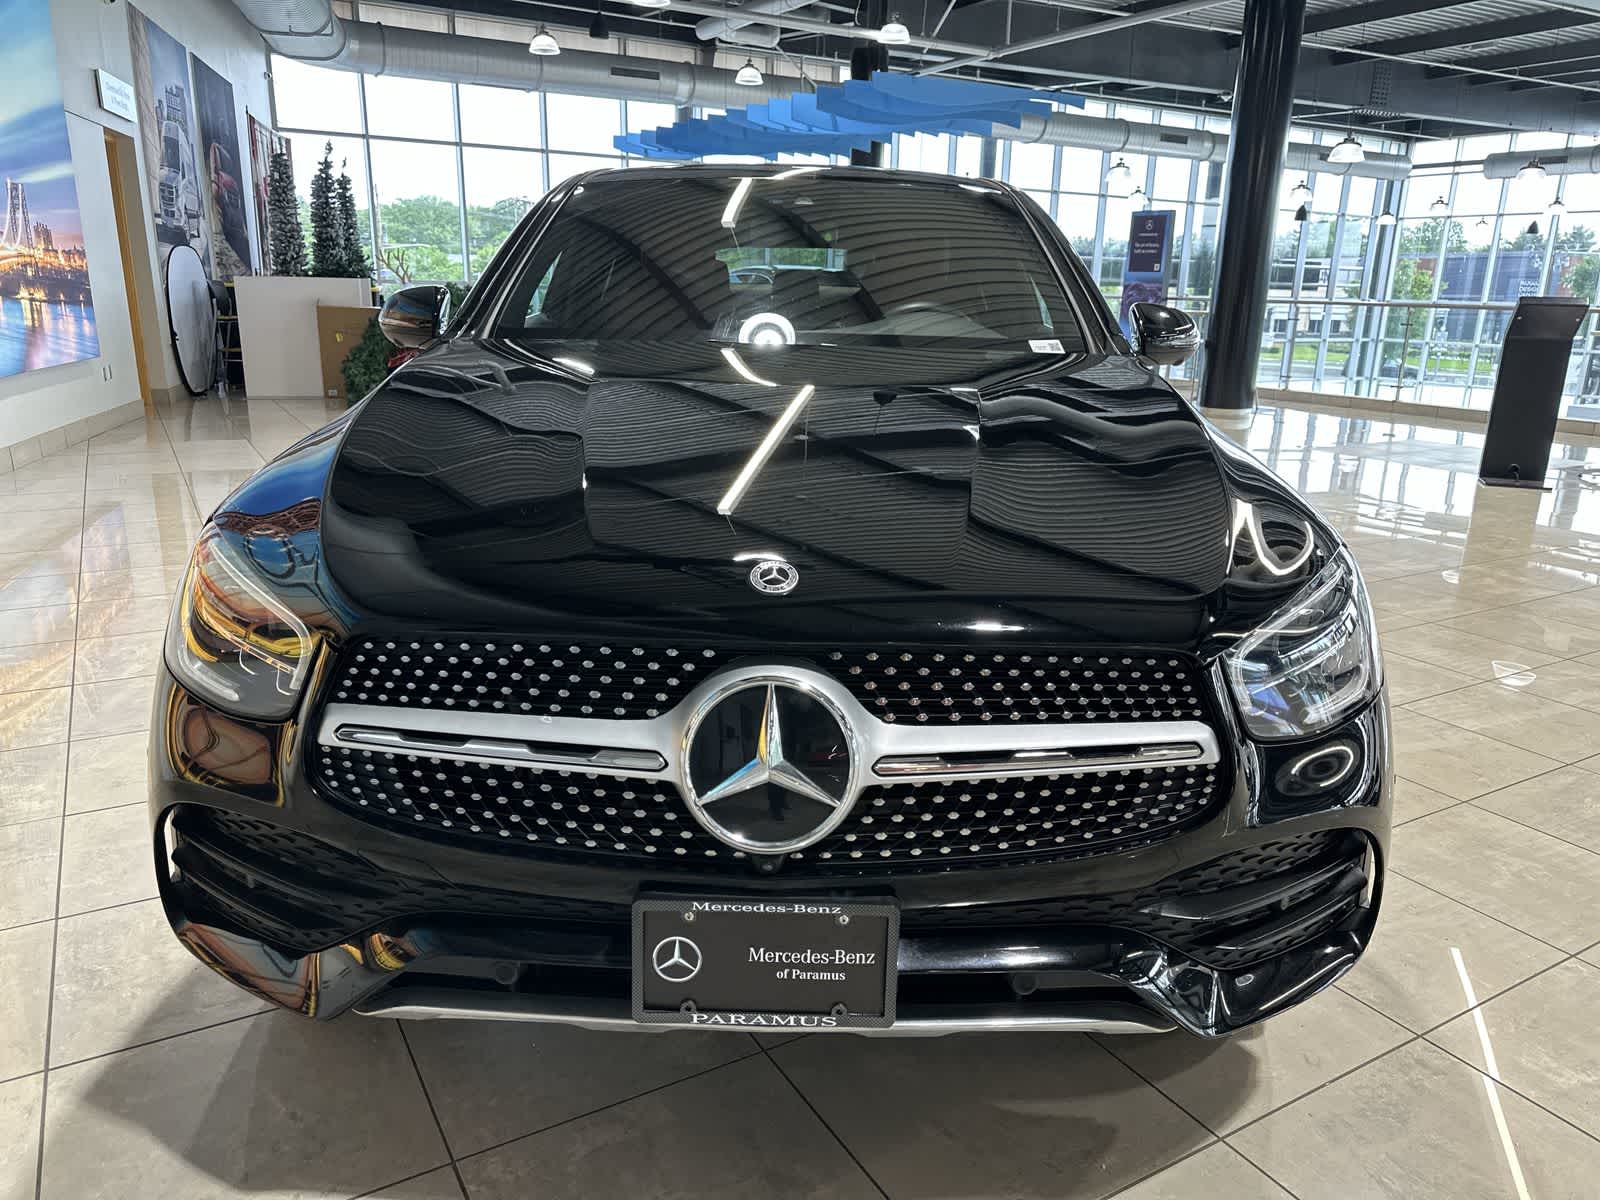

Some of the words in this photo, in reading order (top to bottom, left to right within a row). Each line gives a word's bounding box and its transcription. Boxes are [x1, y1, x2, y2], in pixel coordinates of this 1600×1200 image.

[691, 901, 842, 914] Mercedes-Benz
[748, 947, 876, 965] Mercedes-Benz
[776, 969, 789, 980] of
[792, 969, 846, 981] Paramus
[691, 1014, 838, 1027] PARAMUS
